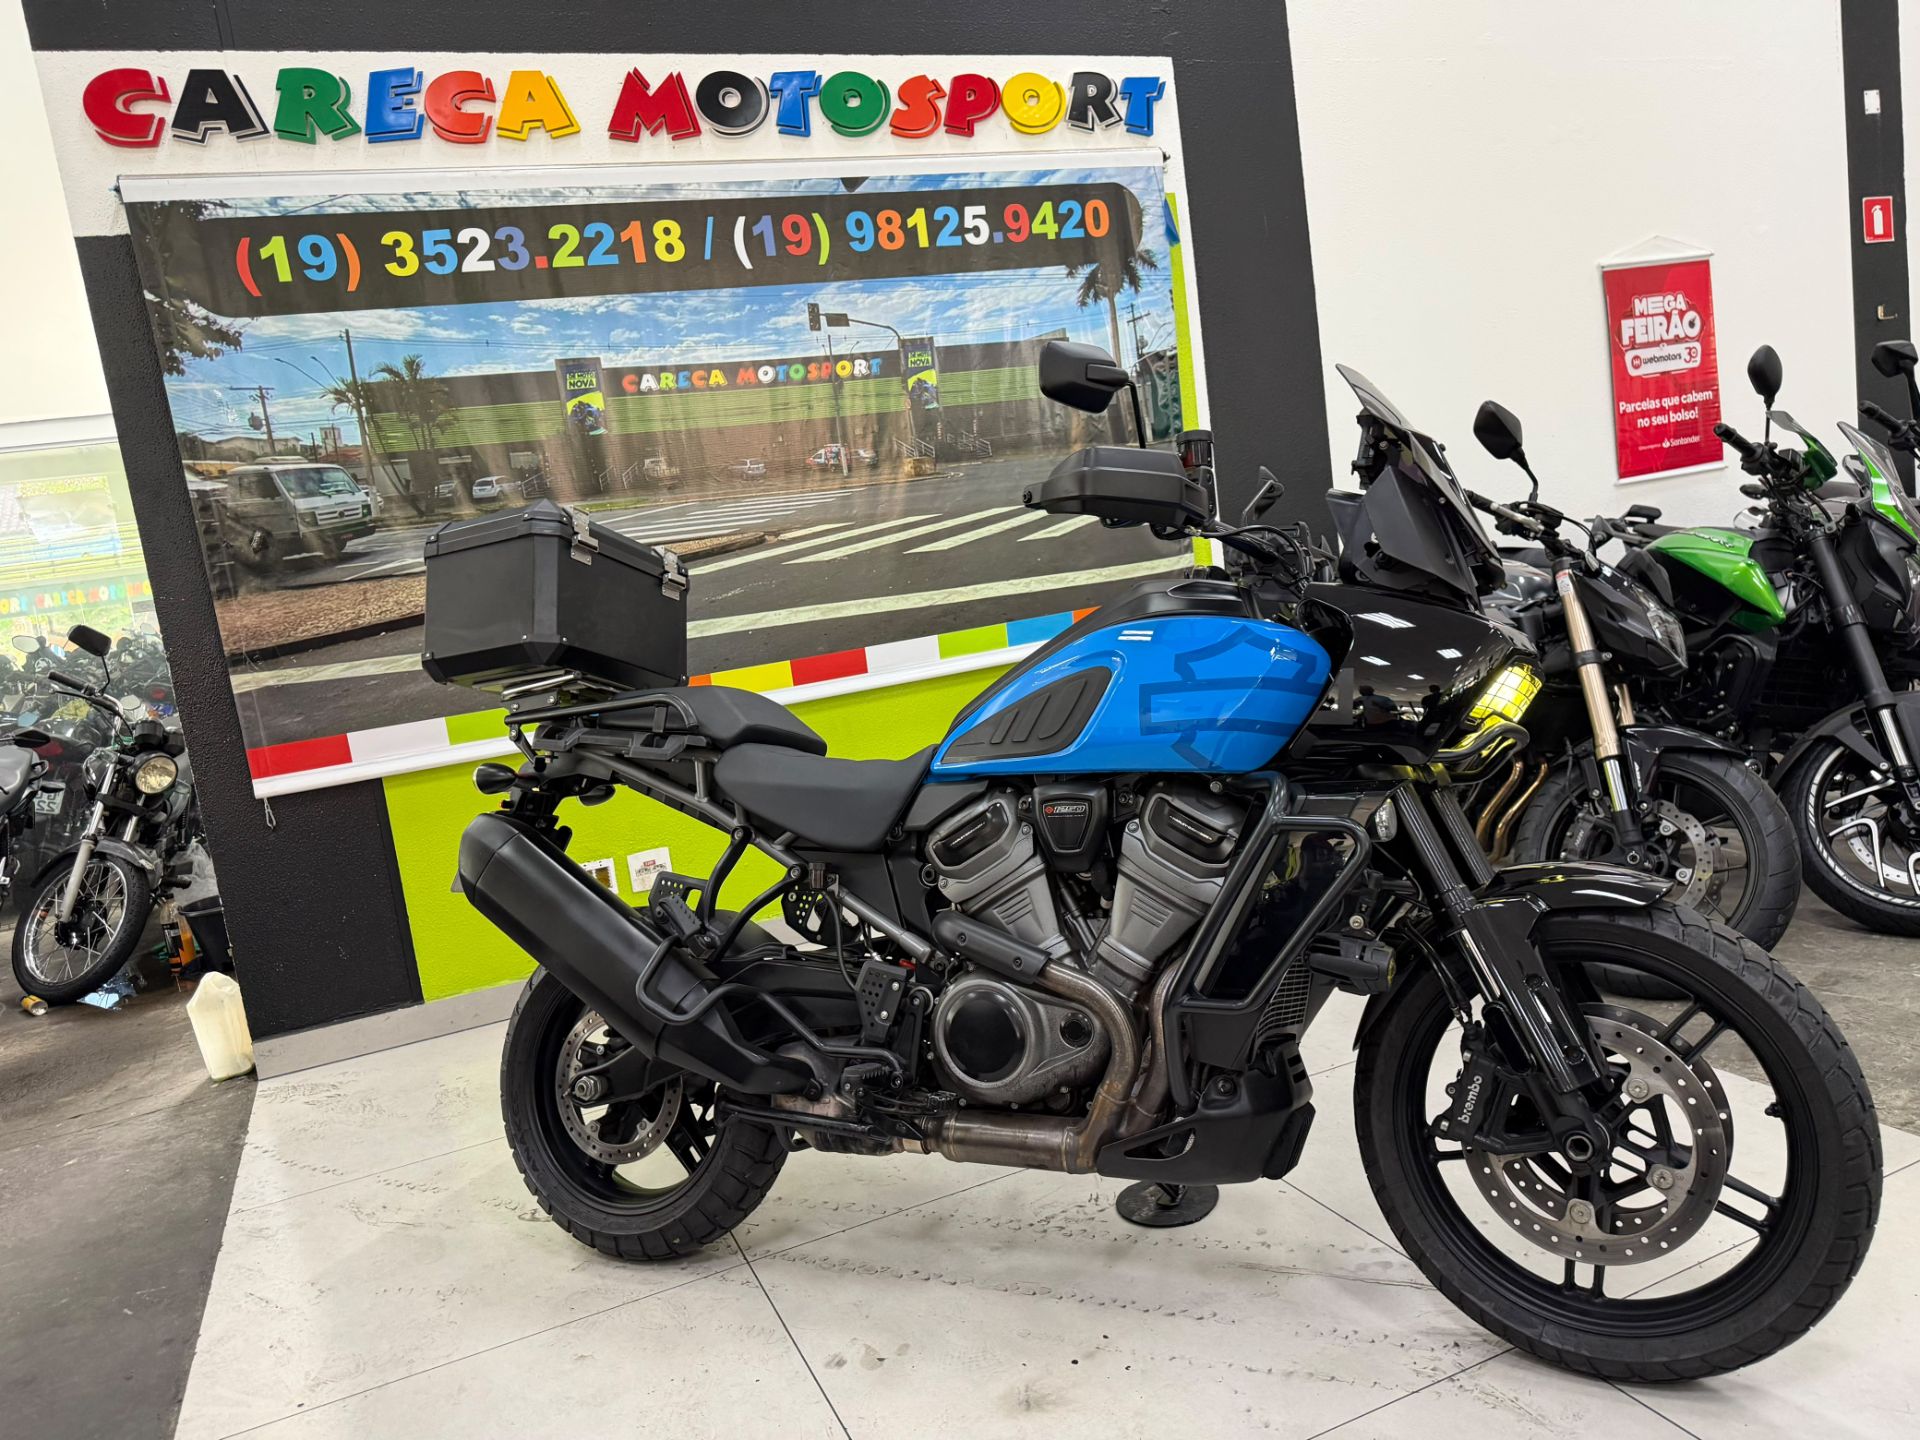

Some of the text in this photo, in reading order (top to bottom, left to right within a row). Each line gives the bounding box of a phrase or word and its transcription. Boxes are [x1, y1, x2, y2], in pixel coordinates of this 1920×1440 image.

[83, 67, 1166, 148] CARECA MOTOSPORT
[235, 233, 361, 296] (19)
[381, 219, 686, 276] 3523.2218
[733, 213, 831, 269] (19)
[846, 199, 1109, 252] 98125.9420
[1634, 294, 1687, 316] MEGA
[1621, 309, 1701, 346] FEIRÃO
[1643, 353, 1682, 365] webmotors
[568, 379, 595, 389] NOVA
[622, 358, 882, 393] CARECA MOTOSPORT
[1619, 390, 1713, 414] Parcelas que cabem
[1637, 406, 1699, 428] no seu bolso!
[1457, 1075, 1482, 1124] brembo
